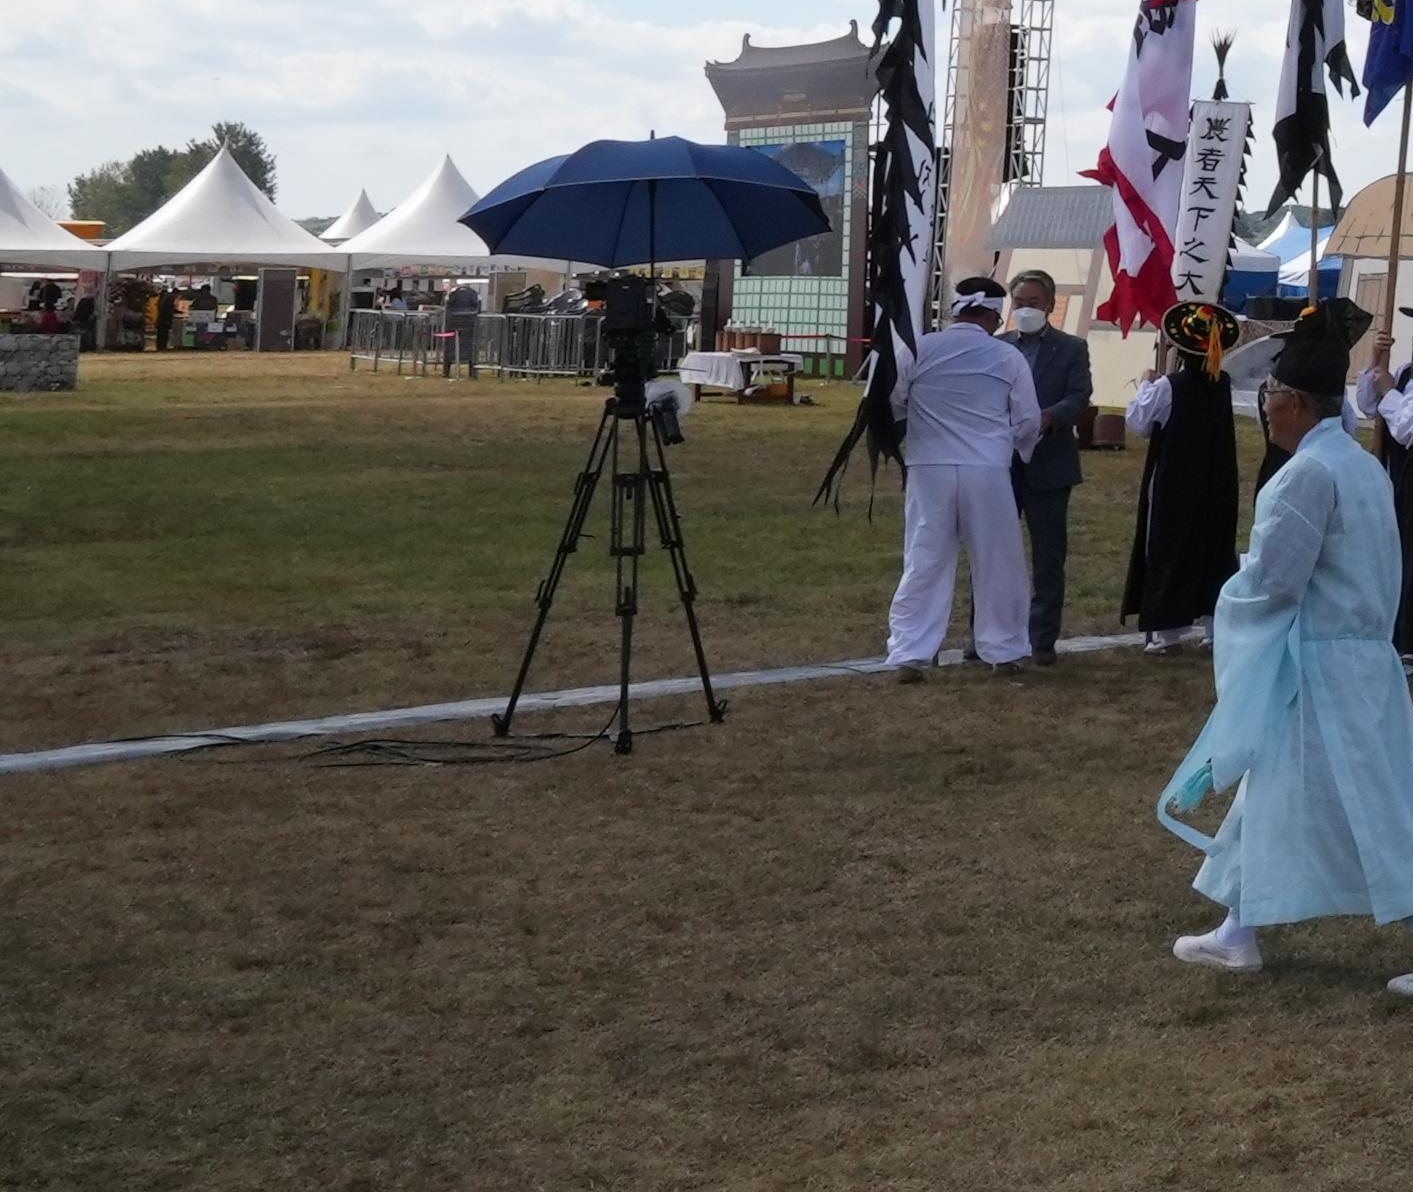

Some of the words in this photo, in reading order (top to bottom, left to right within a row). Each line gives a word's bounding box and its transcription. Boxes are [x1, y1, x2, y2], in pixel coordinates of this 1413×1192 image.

[1176, 117, 1232, 302] 農者天下之大
